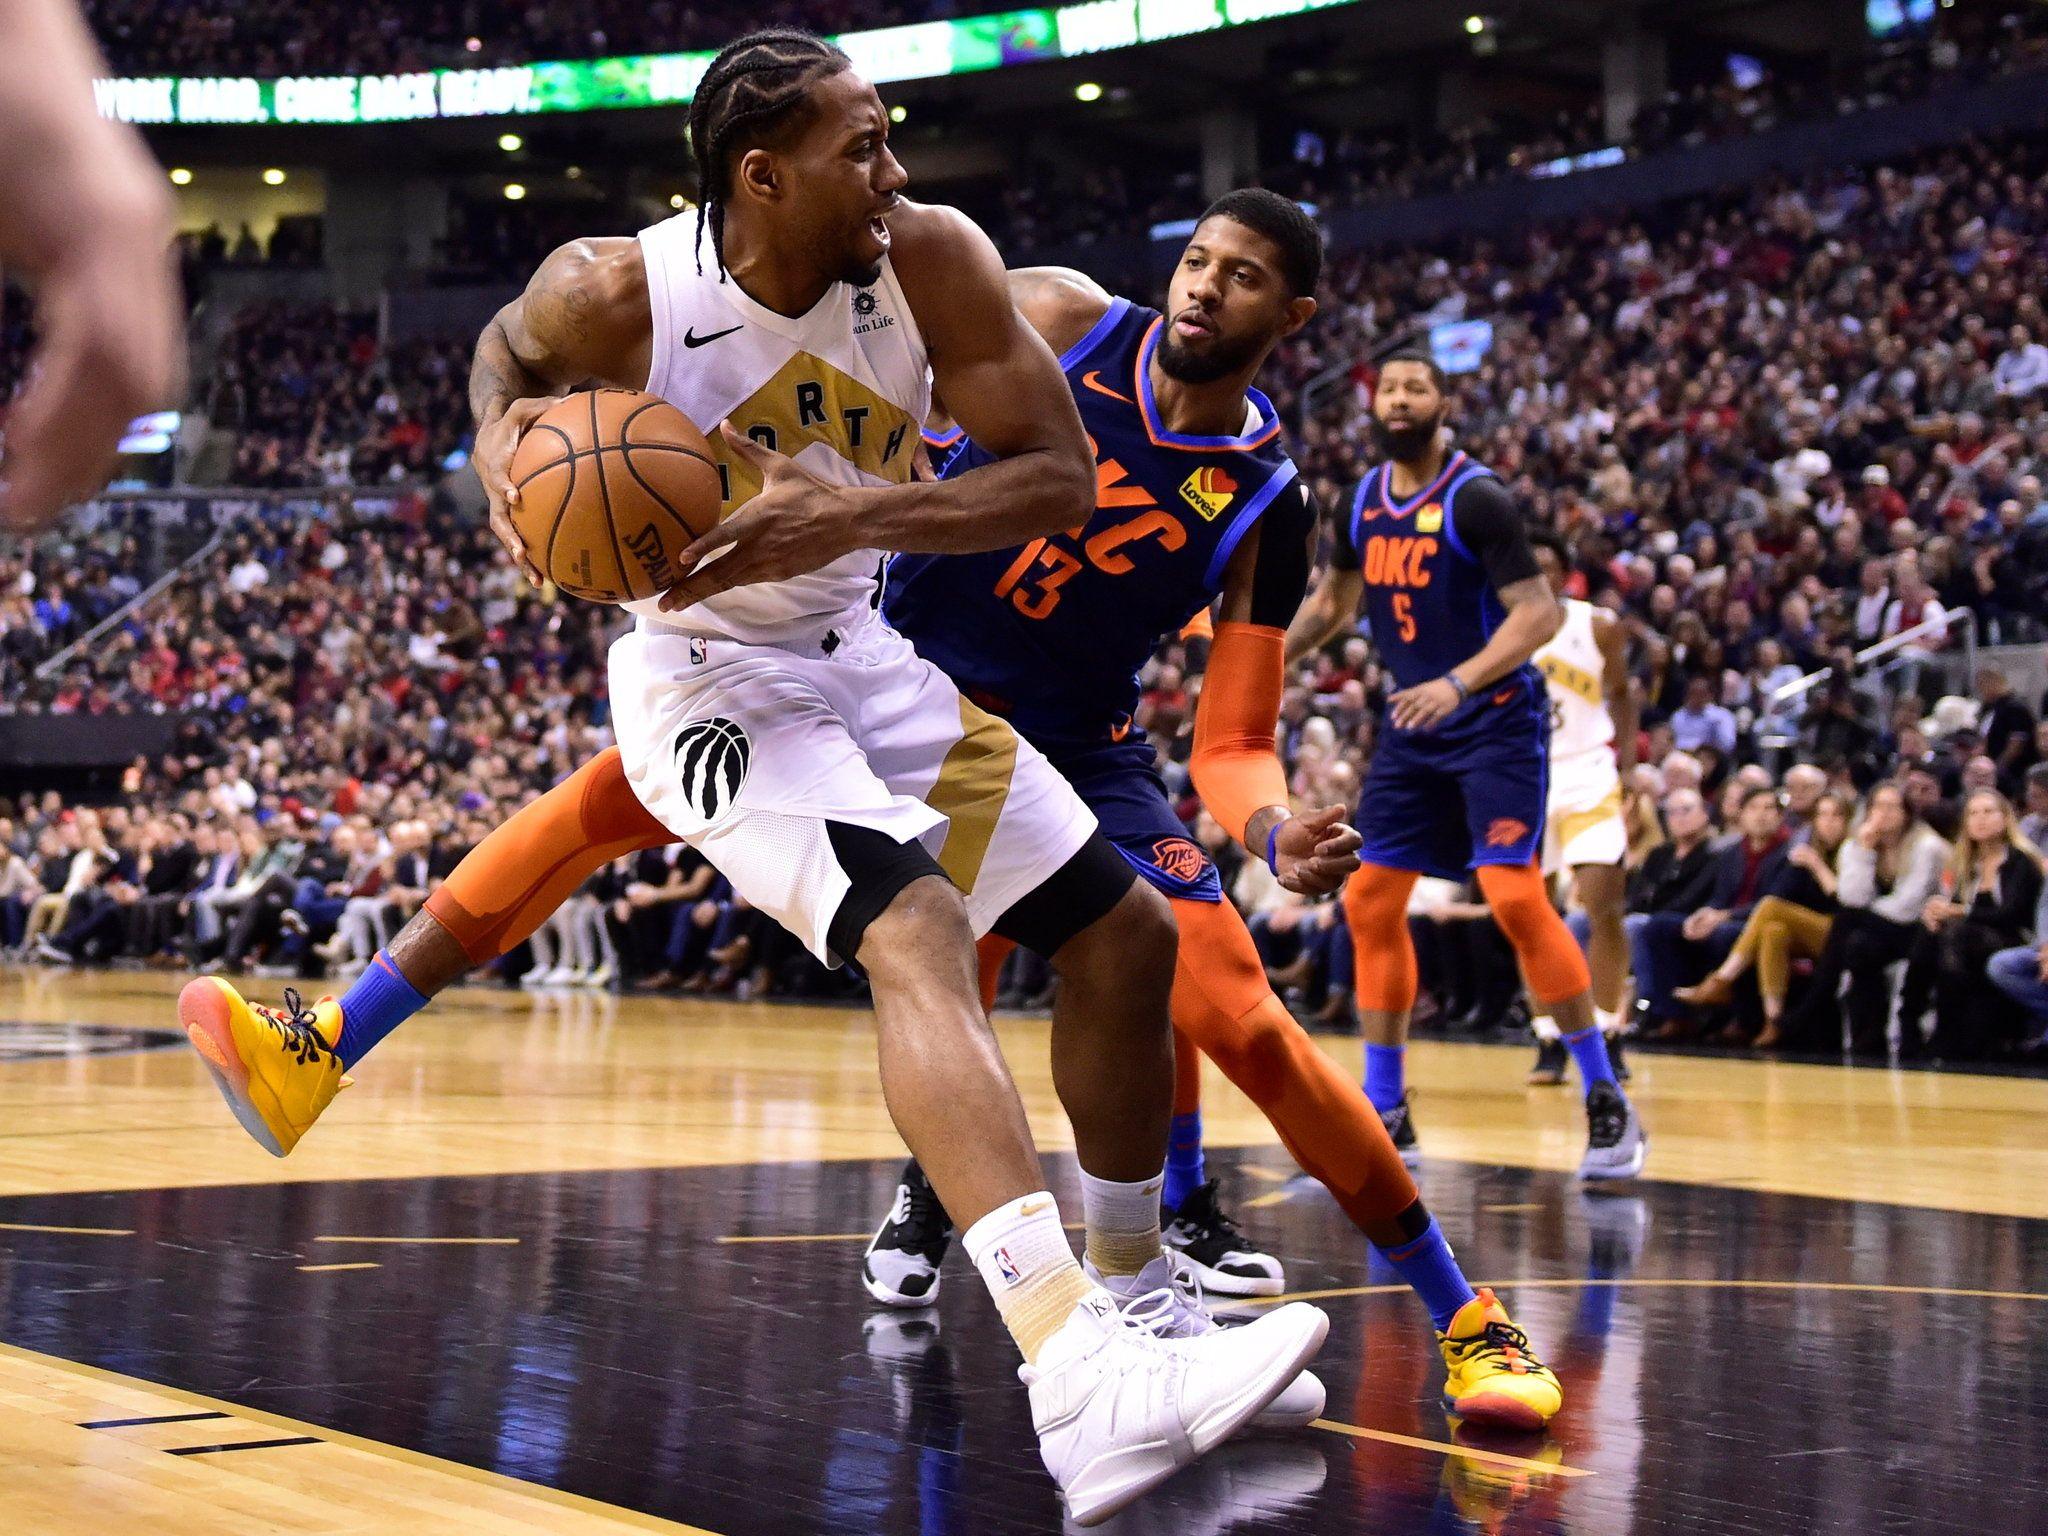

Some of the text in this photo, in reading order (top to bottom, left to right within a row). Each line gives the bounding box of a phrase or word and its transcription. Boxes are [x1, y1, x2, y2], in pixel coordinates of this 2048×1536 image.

[275, 75, 358, 123] COME
[872, 315, 895, 330] Life
[1066, 432, 1188, 576] KC
[993, 536, 1084, 621] 13
[1364, 535, 1438, 588] OKC
[1392, 592, 1416, 643] 5
